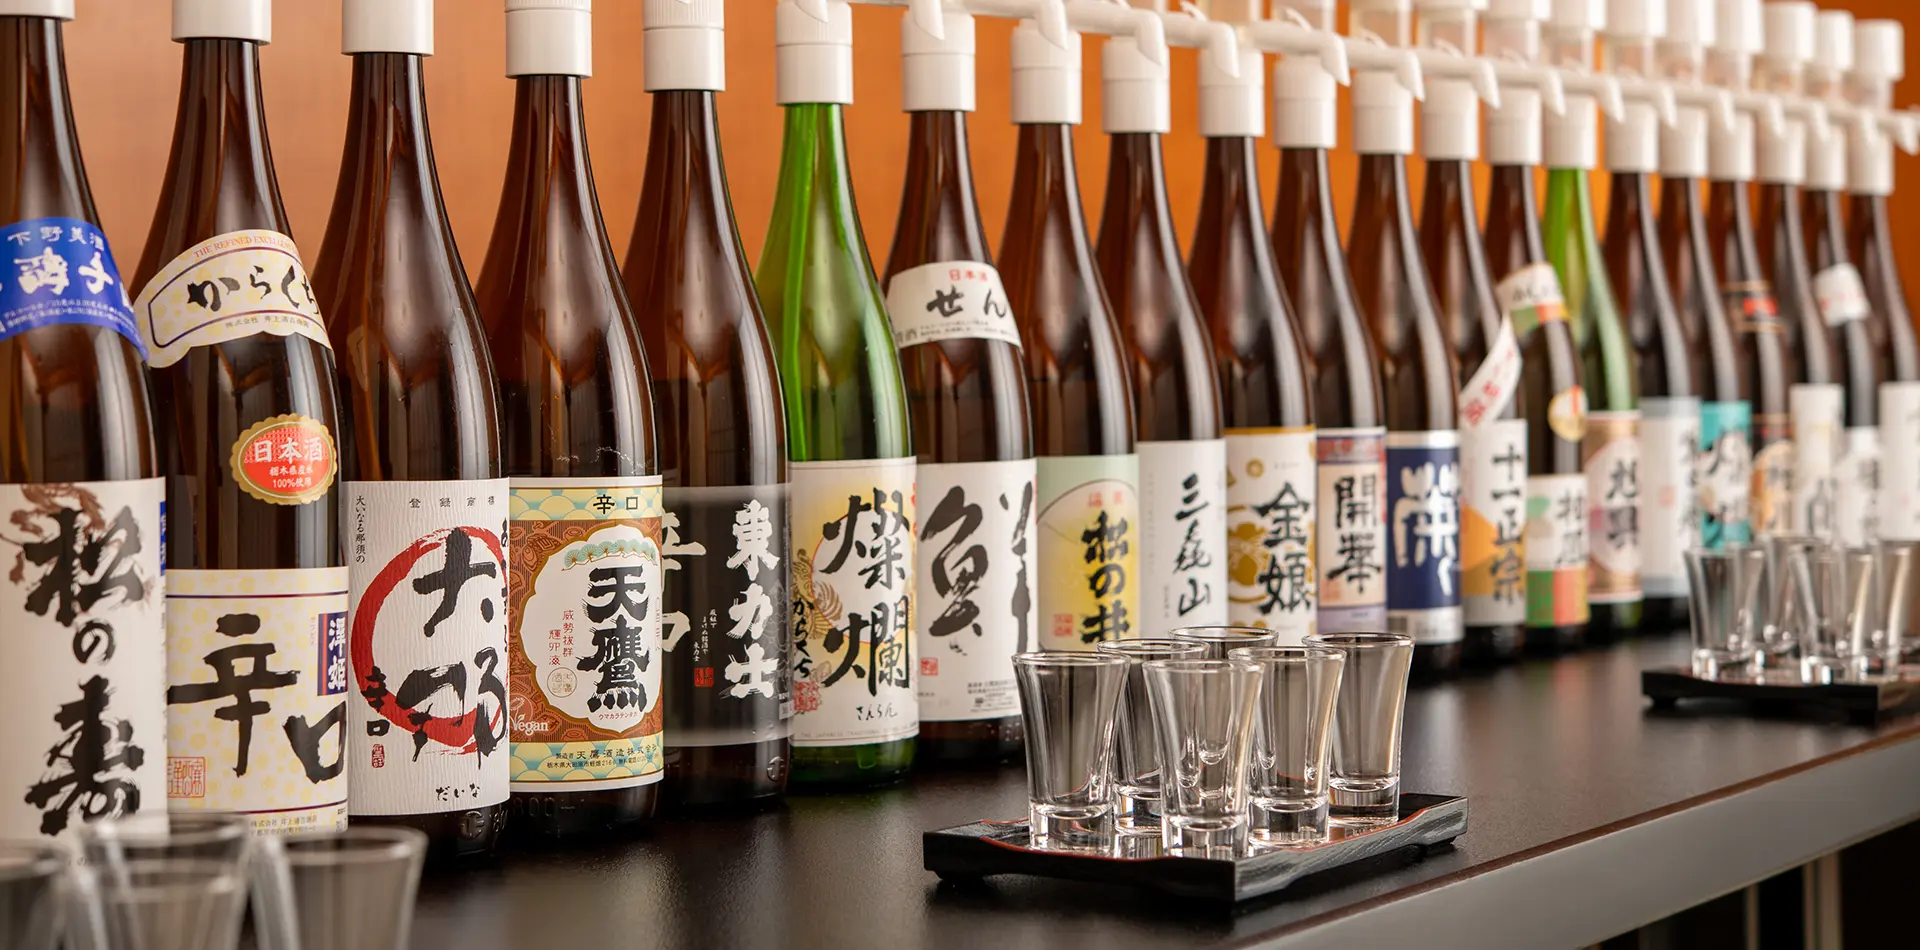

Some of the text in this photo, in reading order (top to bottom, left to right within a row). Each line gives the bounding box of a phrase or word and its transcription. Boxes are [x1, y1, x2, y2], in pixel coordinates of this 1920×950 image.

[193, 246, 213, 258] THE
[214, 236, 253, 251] REFINED
[926, 285, 1006, 318] せん
[253, 437, 323, 464] 日本酒
[272, 477, 313, 489] 100%使用
[592, 493, 640, 515] 辛口
[354, 495, 367, 565] 大いなる那須の
[724, 499, 780, 699] 東力士
[576, 563, 652, 714] 天鷹
[509, 713, 549, 737] Vegan
[435, 782, 480, 802] だいな
